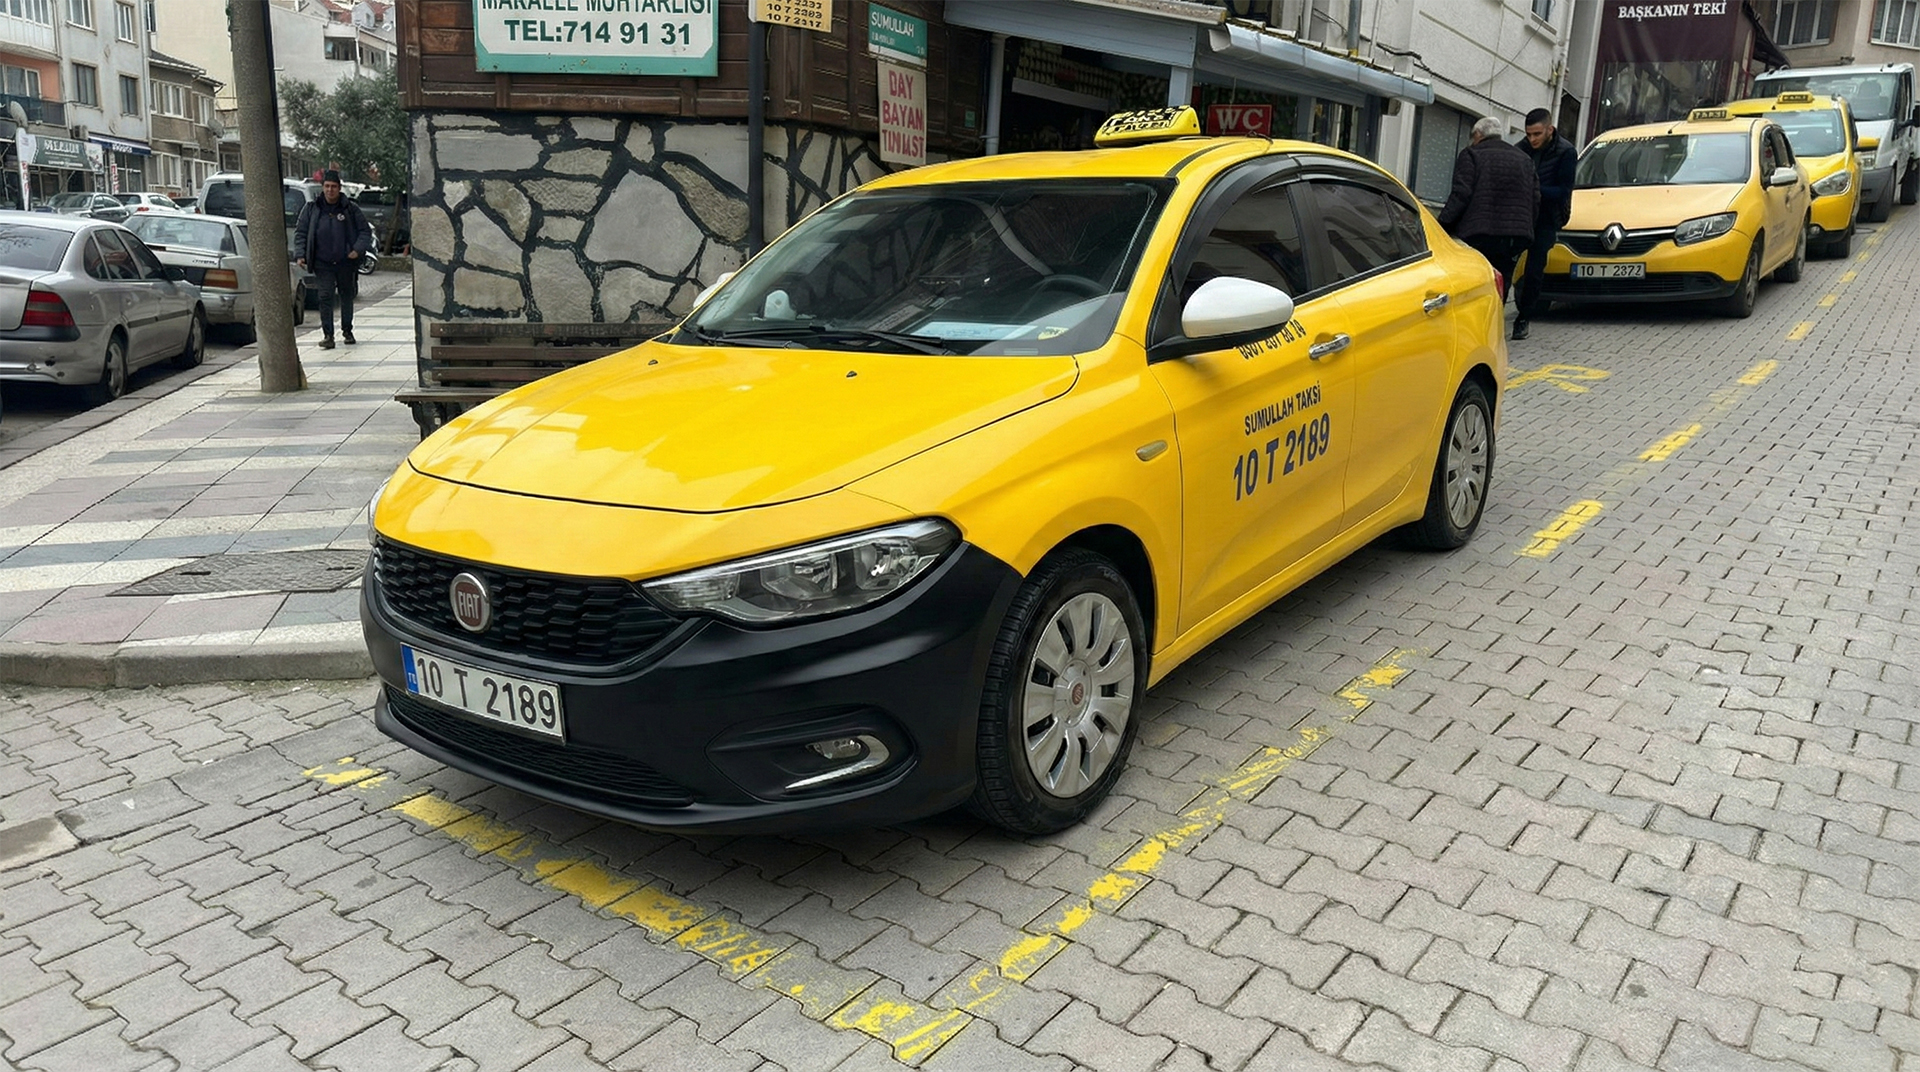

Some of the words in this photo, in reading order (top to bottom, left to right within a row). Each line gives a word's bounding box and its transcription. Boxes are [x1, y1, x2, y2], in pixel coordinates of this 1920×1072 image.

[766, 3, 781, 11] 10
[766, 13, 781, 21] 10
[1617, 4, 1690, 22] BAŞKANIN
[1692, 0, 1727, 15] TEKİ
[504, 20, 611, 43] TEL:714
[620, 22, 648, 44] 91
[660, 23, 690, 45] 31
[871, 11, 914, 38] SUMULLAH
[882, 100, 924, 132] BAYAN
[1215, 108, 1263, 131] WC
[1580, 265, 1595, 277] 10
[1600, 265, 1608, 277] T
[1244, 396, 1294, 436] SUMULLAH
[1233, 448, 1259, 501] 10
[1265, 437, 1280, 485] T
[1283, 412, 1330, 476] 2189
[417, 657, 444, 698] 10
[453, 667, 468, 708] T
[482, 676, 556, 730] 2189
